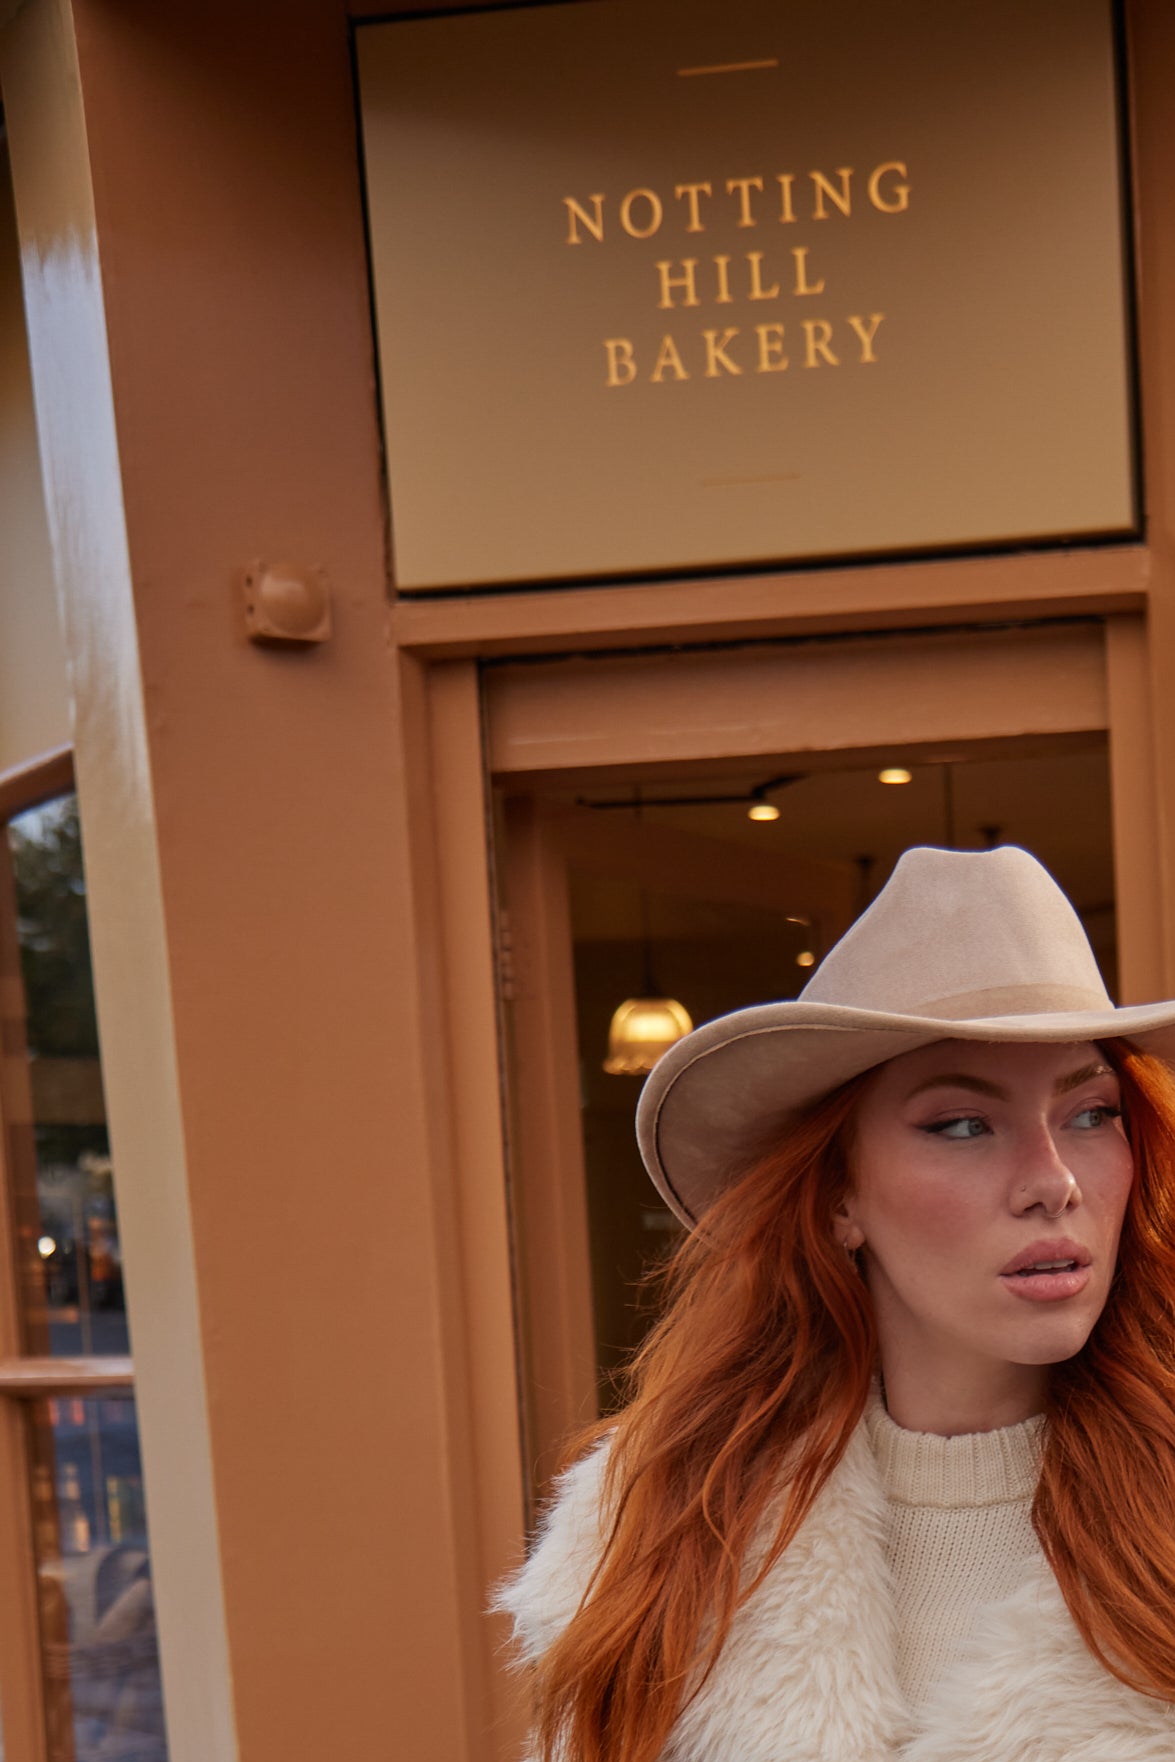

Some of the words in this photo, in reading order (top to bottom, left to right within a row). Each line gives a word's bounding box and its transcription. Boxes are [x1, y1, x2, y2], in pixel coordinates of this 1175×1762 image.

[563, 161, 911, 245] NOTTING
[655, 246, 825, 310] HILL
[603, 312, 885, 388] BAKERY
